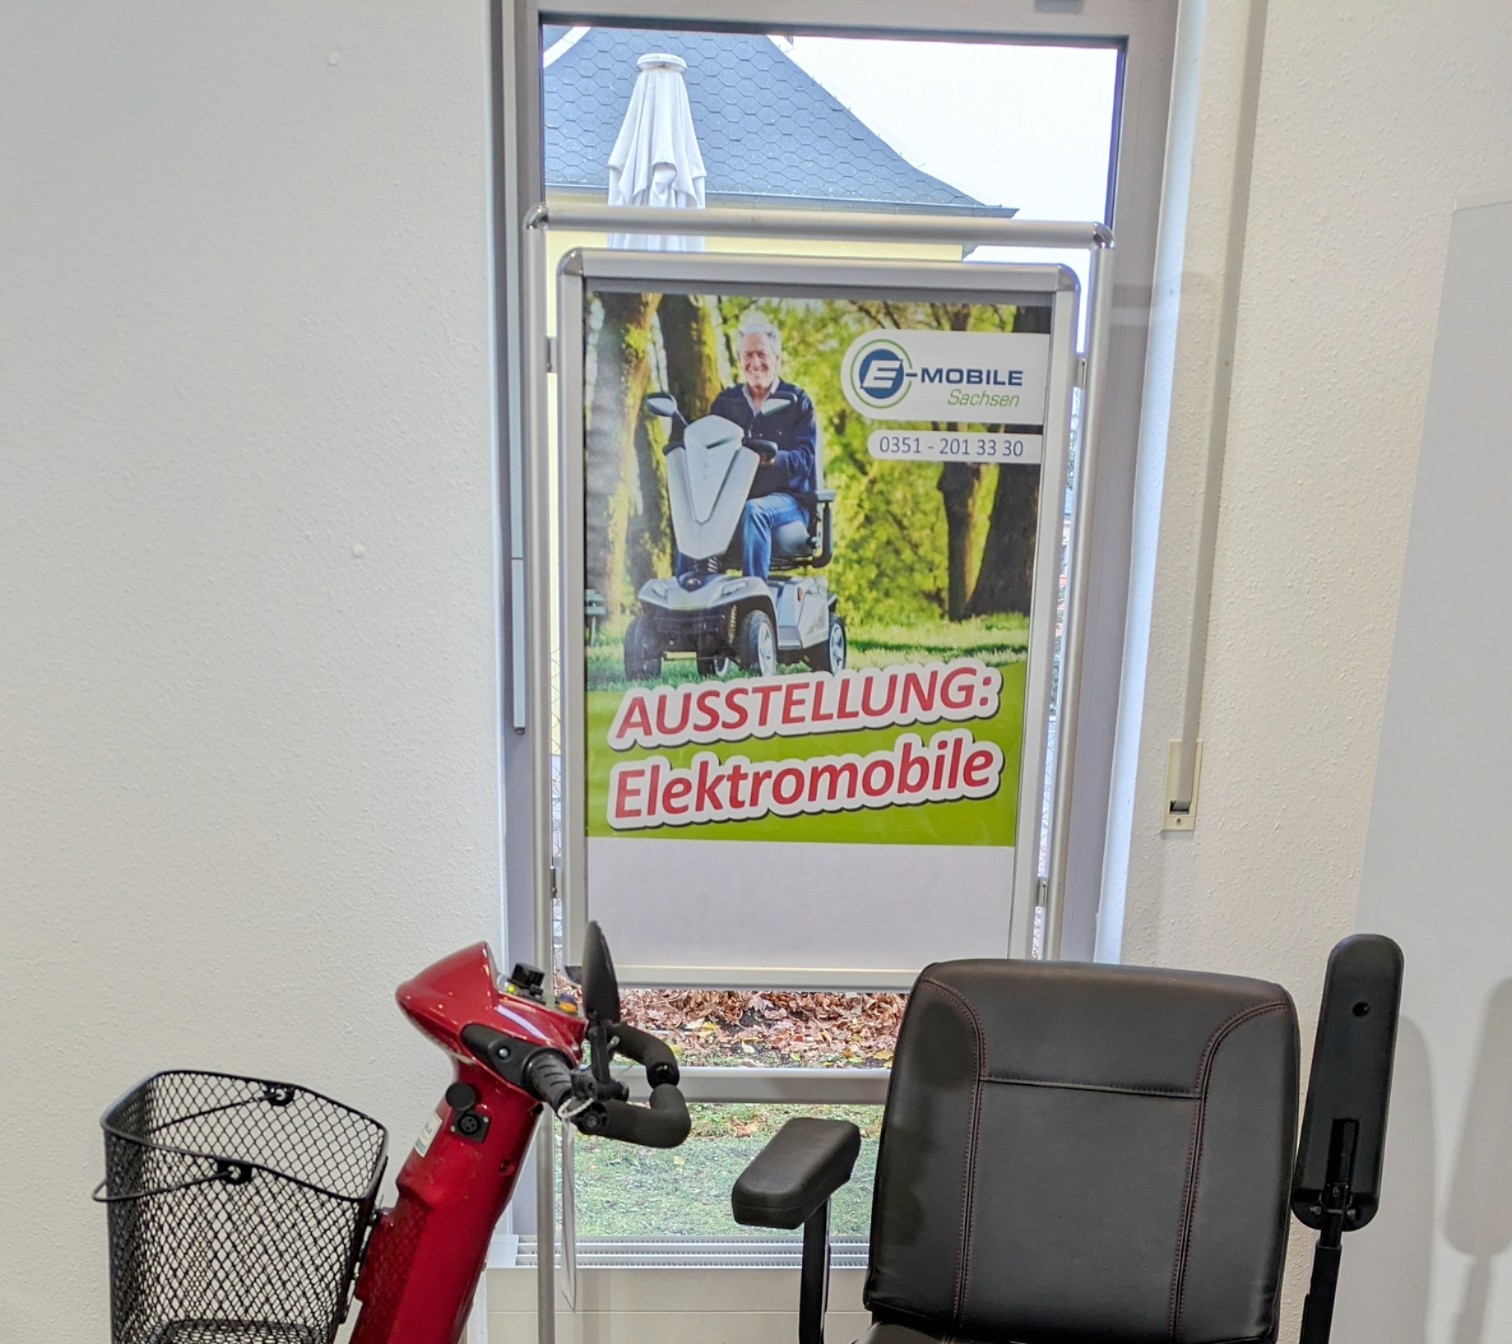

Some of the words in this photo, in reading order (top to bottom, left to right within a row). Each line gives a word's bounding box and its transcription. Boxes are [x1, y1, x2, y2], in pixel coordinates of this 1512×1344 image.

[860, 358, 1024, 390] E-MOBILE
[947, 388, 1020, 408] Sachsen
[879, 436, 922, 454] 0351
[939, 438, 971, 456] 201
[976, 439, 997, 456] 33
[1002, 440, 1024, 457] 30
[616, 666, 992, 739] AUSSTELLUNG:
[615, 737, 994, 819] Elektromobile
